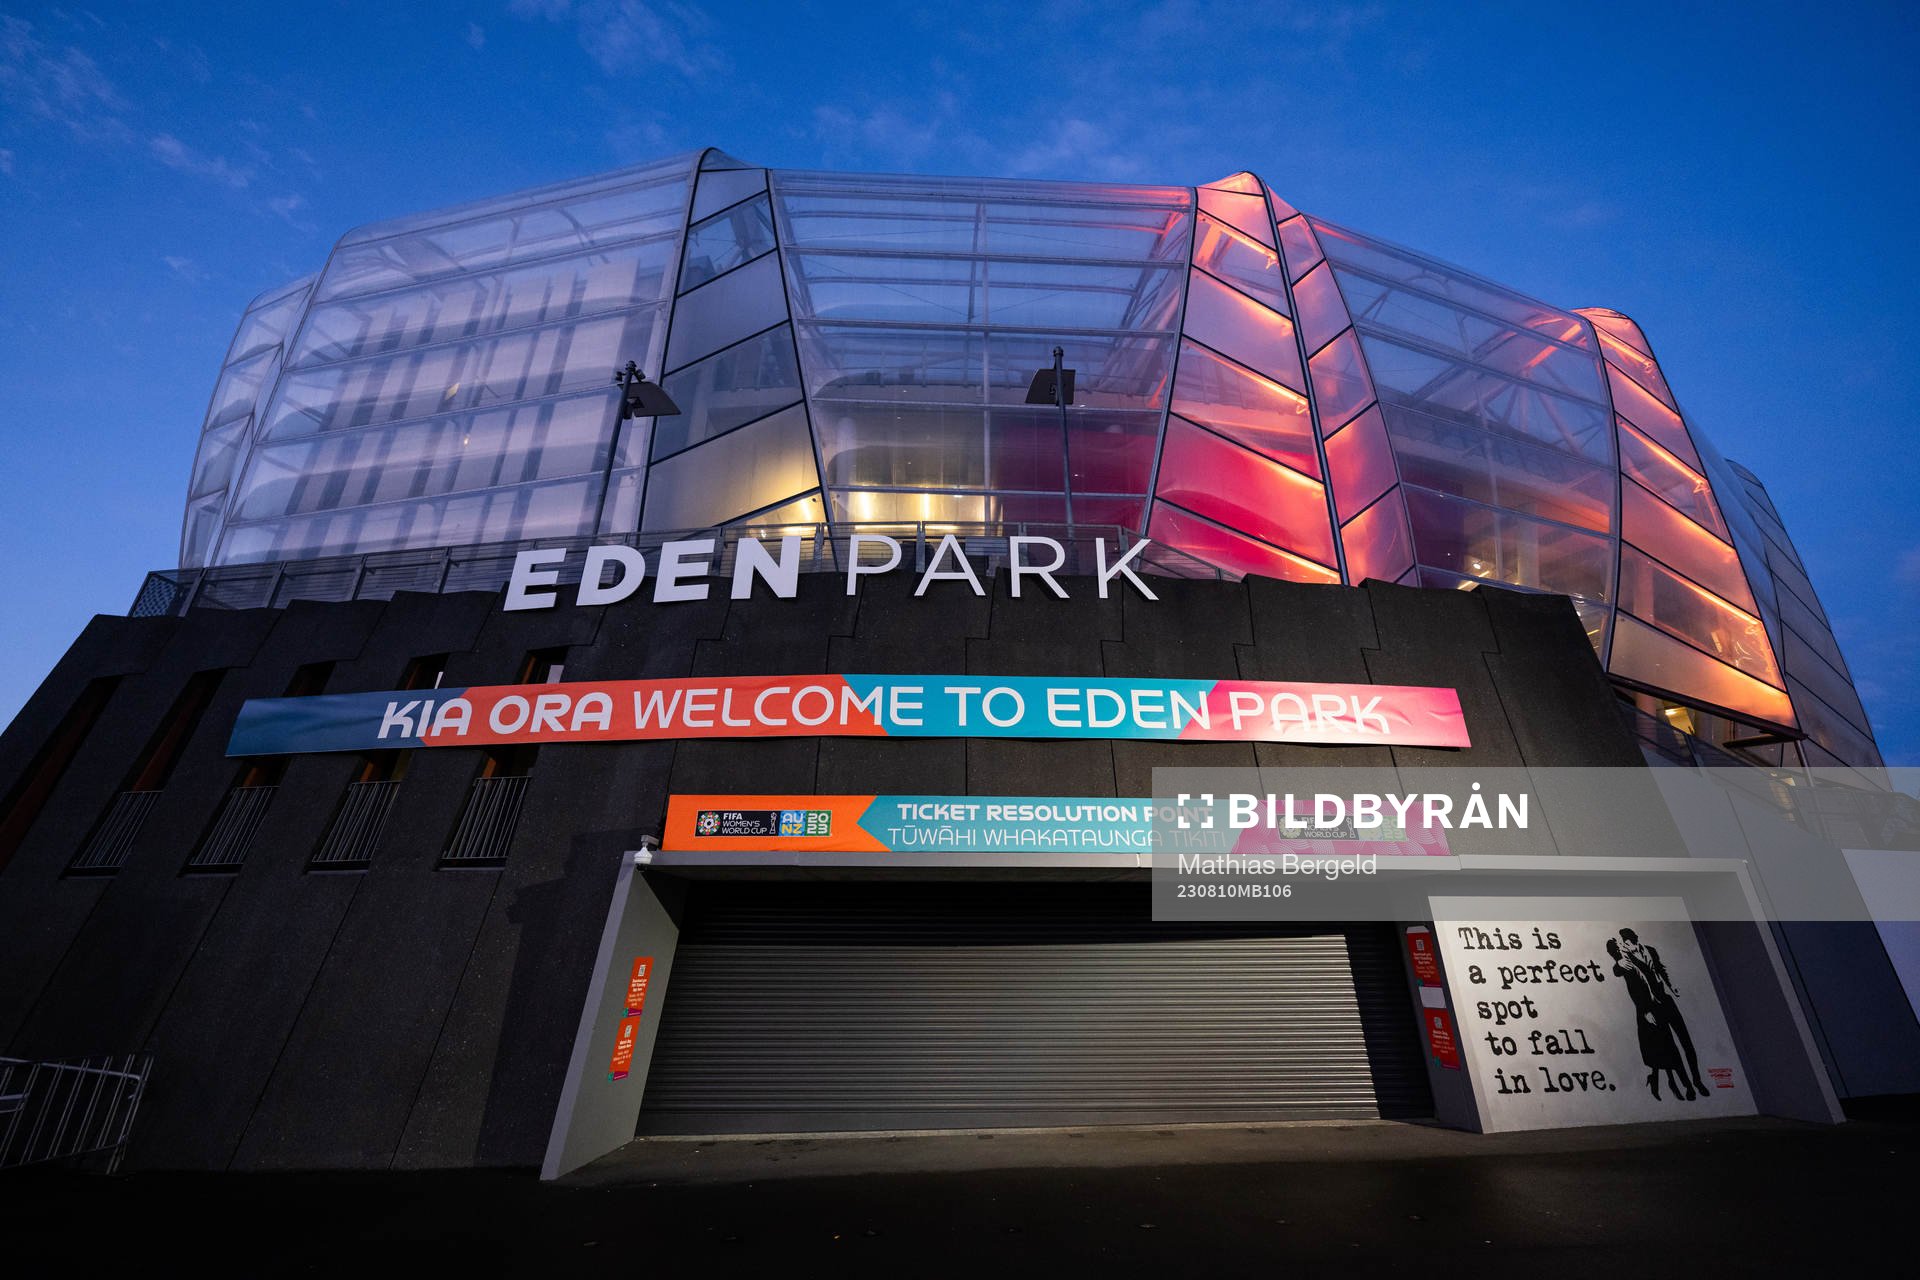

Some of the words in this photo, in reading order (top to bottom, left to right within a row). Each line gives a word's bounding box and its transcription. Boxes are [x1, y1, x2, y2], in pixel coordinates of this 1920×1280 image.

[503, 536, 801, 611] EDEN
[846, 535, 1159, 601] PARK
[377, 698, 472, 739] KIA
[489, 692, 613, 735] ORA
[634, 685, 923, 729] WELCOME
[944, 687, 1025, 727] TO
[1046, 688, 1211, 730] EDEN
[1229, 691, 1391, 735] PARK
[782, 813, 804, 823] AU
[807, 813, 828, 823] 20
[897, 803, 980, 821] TICKET
[987, 805, 1137, 823] RESOLUTION
[721, 826, 750, 834] WORLD
[751, 826, 767, 834] CUP
[781, 824, 802, 834] NZ
[807, 823, 828, 833] 23
[888, 825, 976, 846] TŪWĀHI
[984, 828, 1163, 847] WHAKATAUNGA
[1168, 830, 1227, 847] TIKITI
[1457, 926, 1523, 950] This
[1532, 927, 1562, 950] is
[1468, 965, 1486, 984] a
[1497, 960, 1605, 989] perfect
[1477, 995, 1539, 1025] spot
[1485, 1031, 1517, 1056] to
[1528, 1029, 1595, 1055] fall
[1494, 1068, 1531, 1094] in
[1539, 1066, 1617, 1093] love.
